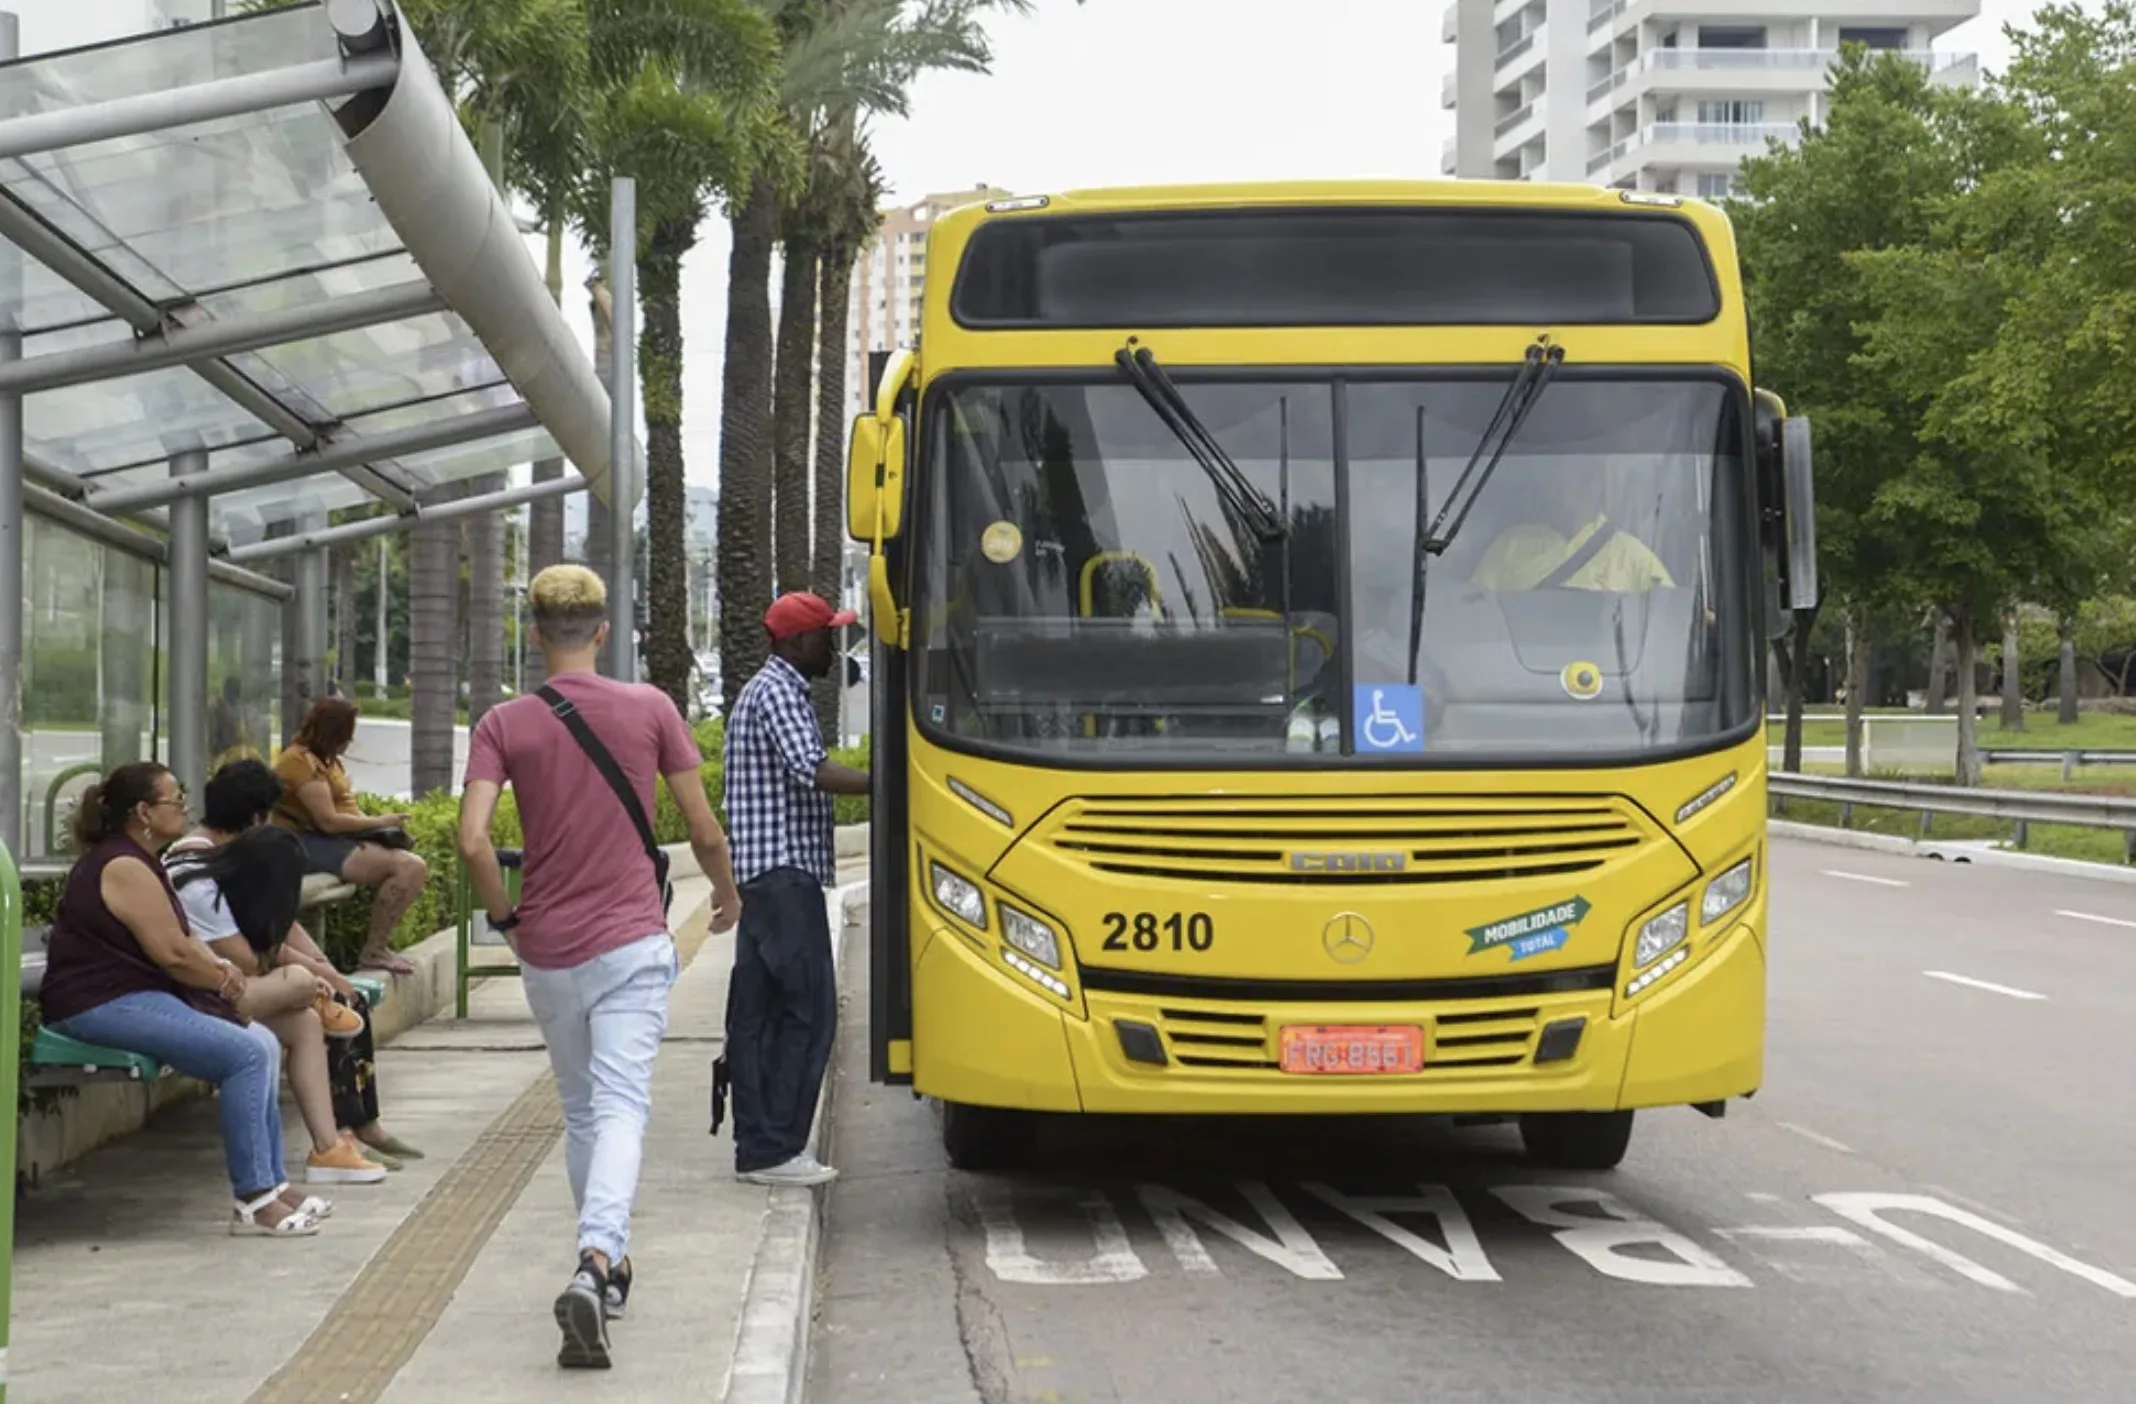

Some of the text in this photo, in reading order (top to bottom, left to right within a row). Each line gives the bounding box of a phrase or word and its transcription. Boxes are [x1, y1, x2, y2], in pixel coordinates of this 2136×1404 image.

[1102, 911, 1213, 952] 2810
[1484, 902, 1576, 944] MOBILIDADE
[1519, 934, 1556, 953] TOTAL
